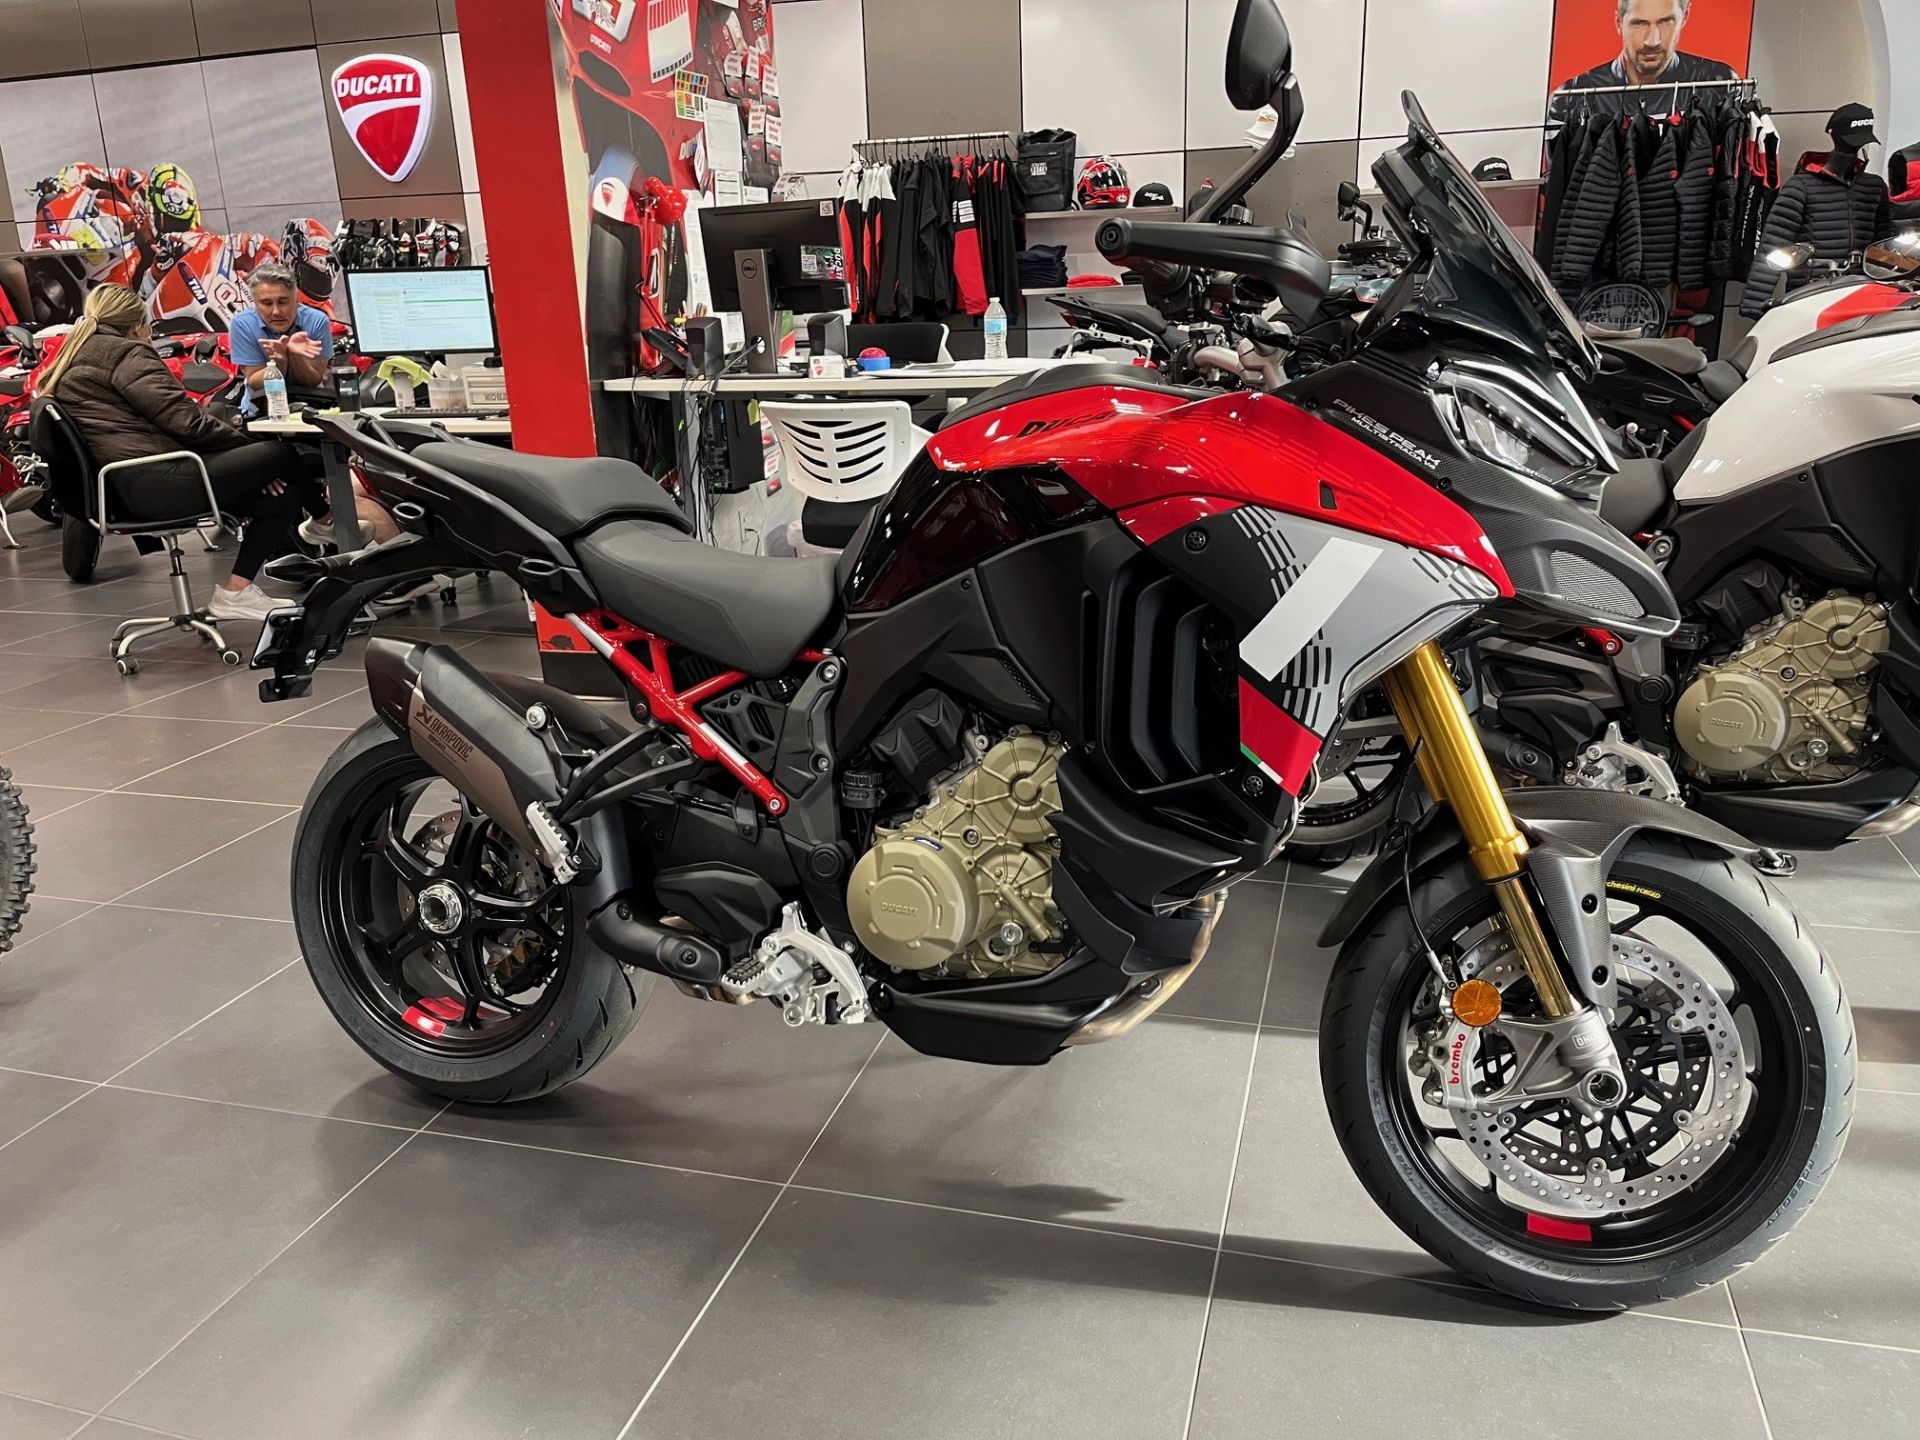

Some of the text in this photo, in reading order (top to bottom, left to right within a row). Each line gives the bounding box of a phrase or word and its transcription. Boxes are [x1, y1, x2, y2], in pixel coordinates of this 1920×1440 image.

[336, 72, 416, 98] DUCATI
[1850, 118, 1874, 128] DUCA
[743, 265, 756, 273] DELL
[187, 278, 206, 301] TIM
[1333, 398, 1441, 467] PIKES PEAK
[1351, 417, 1422, 463] MULTISTRADA
[1710, 717, 1744, 730] DUCATI
[1636, 887, 1661, 899] FORGED
[881, 902, 919, 918] DUCATI
[1448, 1033, 1466, 1085] brembo
